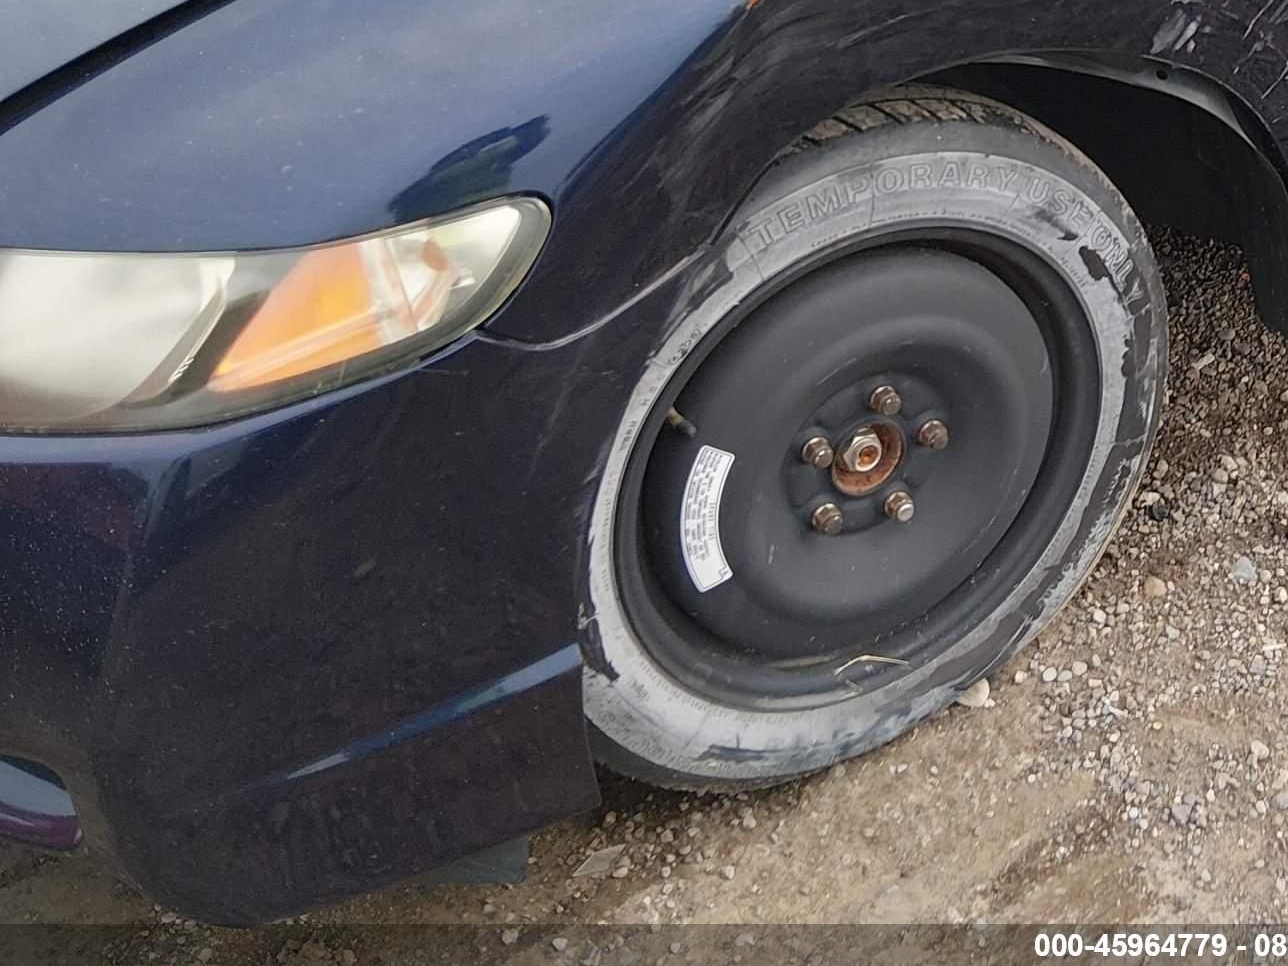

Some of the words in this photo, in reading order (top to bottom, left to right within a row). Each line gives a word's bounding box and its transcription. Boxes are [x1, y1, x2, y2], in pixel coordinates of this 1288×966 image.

[752, 161, 1019, 248] TEMPORARY
[1029, 176, 1095, 229] USE
[1092, 214, 1150, 307] ONLY
